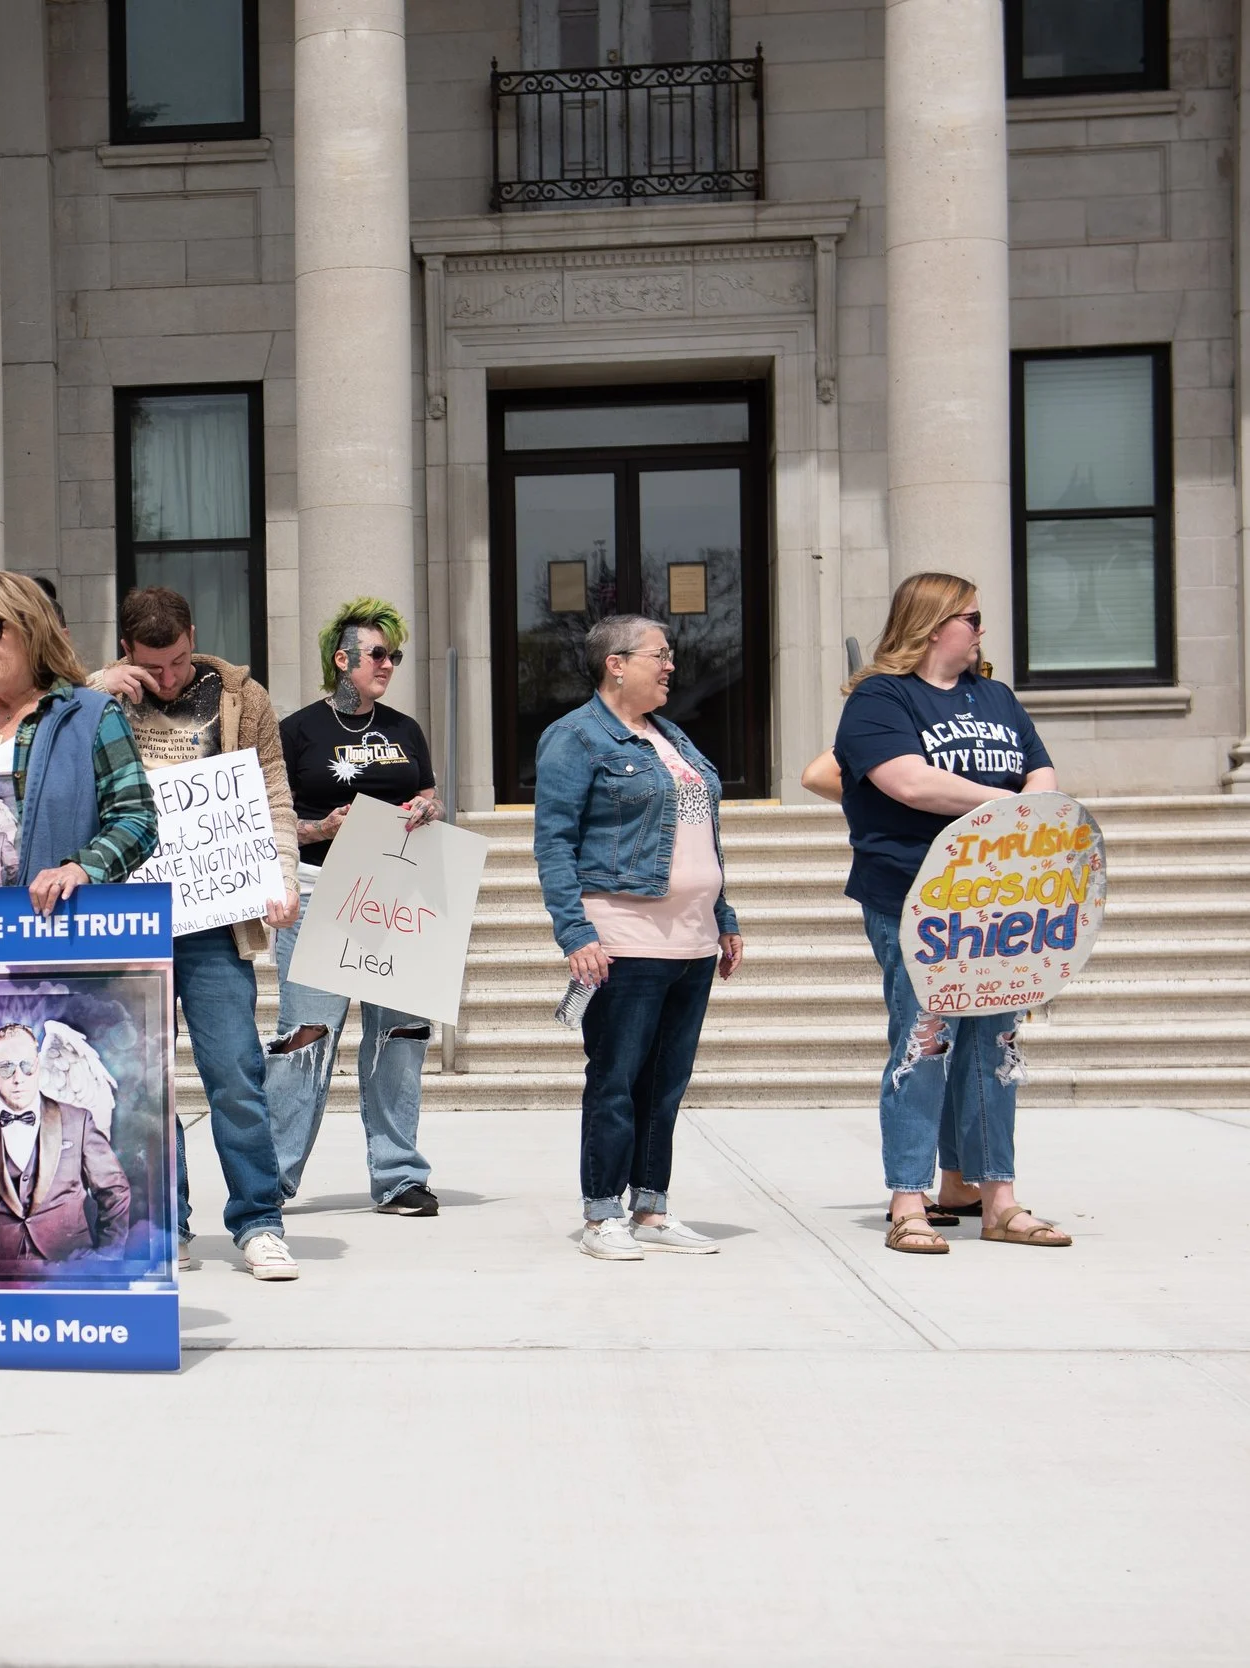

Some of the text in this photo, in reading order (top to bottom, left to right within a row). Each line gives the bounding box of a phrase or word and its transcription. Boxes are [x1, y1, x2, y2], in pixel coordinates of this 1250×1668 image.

[921, 720, 1018, 752] ACADEMY
[931, 749, 1024, 774] IVY RIDGE
[215, 764, 246, 800] OF
[197, 799, 265, 845] SHARE
[971, 813, 993, 828] NO
[1015, 805, 1031, 817] NO
[190, 836, 278, 879] NIGTMARES
[179, 864, 261, 907] REASON
[336, 875, 436, 933] Never
[74, 912, 159, 937] TRUTH
[205, 908, 239, 928] CHILD
[339, 938, 393, 976] Lied
[975, 967, 990, 975] NO
[1013, 966, 1029, 974] NO
[1060, 962, 1070, 979] NO
[976, 981, 1002, 993] NO
[1009, 980, 1025, 988] to
[928, 992, 972, 1012] BAD
[12, 1319, 50, 1343] No
[56, 1319, 129, 1344] More
